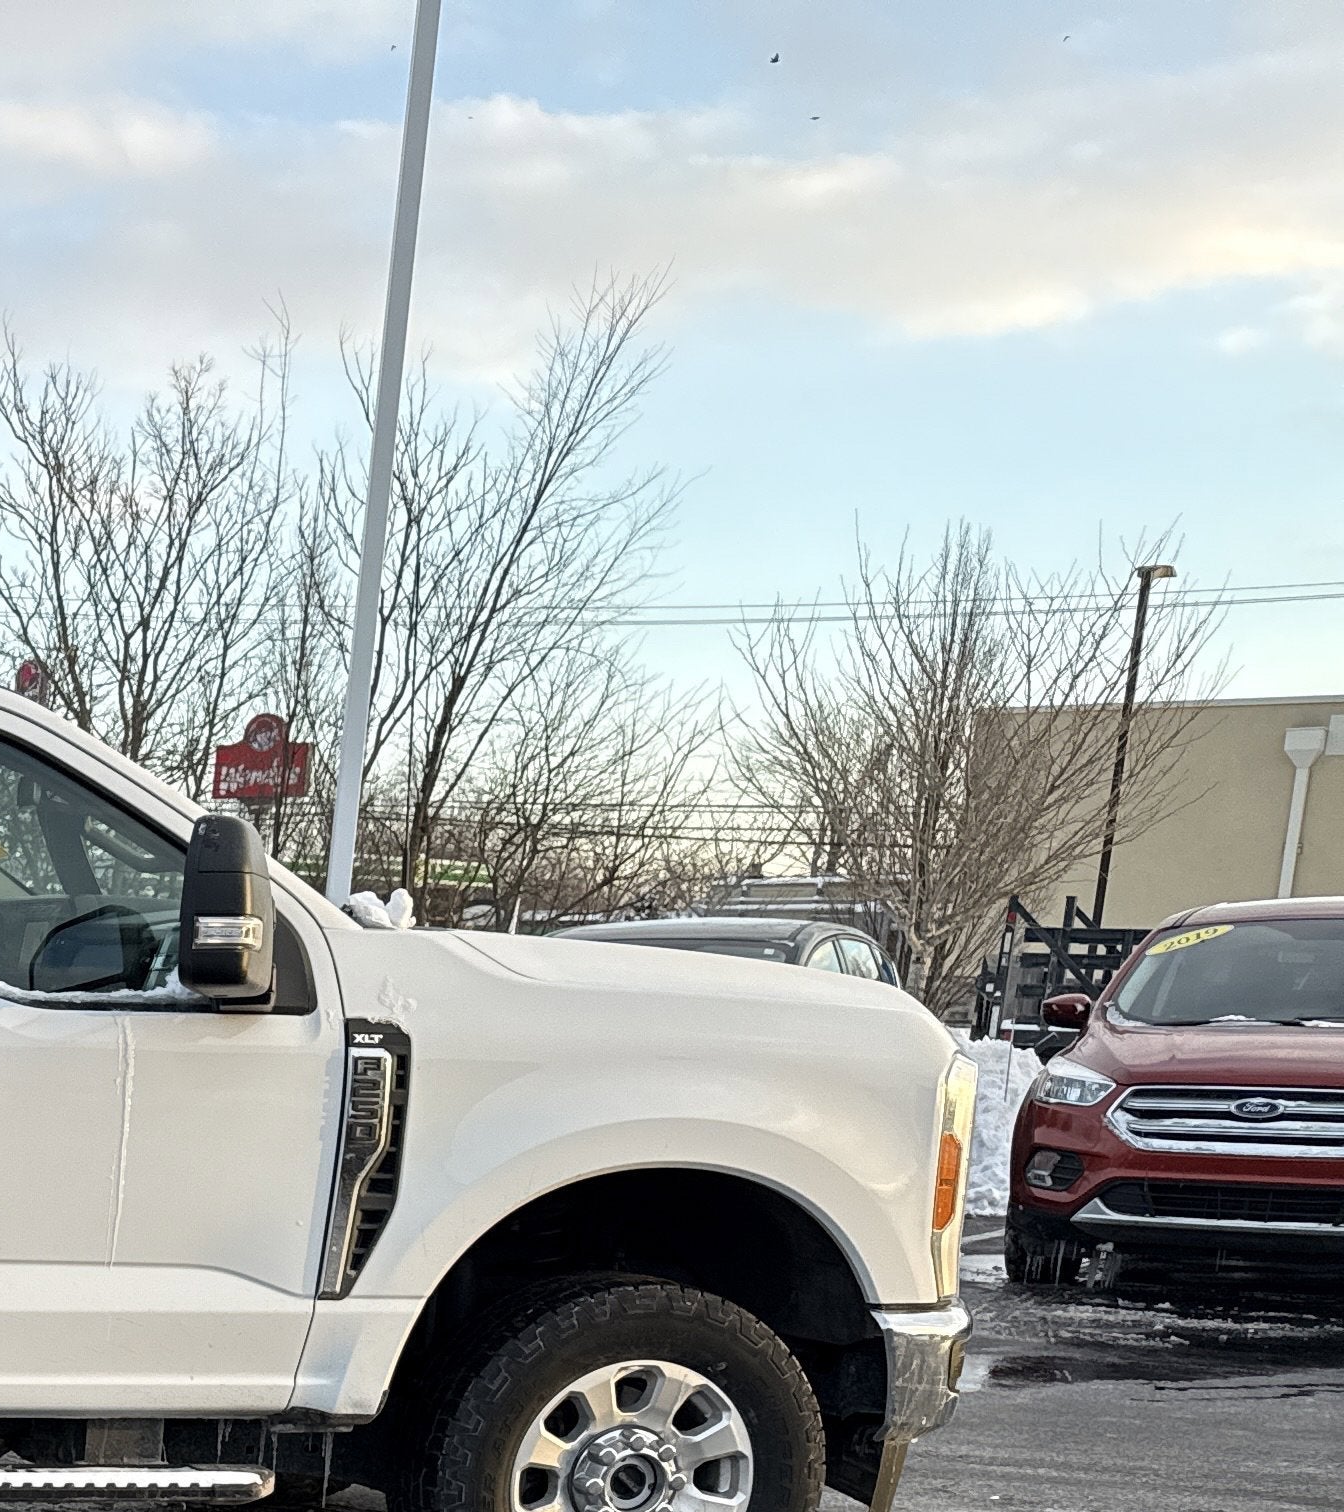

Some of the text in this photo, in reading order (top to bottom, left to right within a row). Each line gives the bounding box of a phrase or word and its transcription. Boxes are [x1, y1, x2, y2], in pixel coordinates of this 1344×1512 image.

[219, 757, 301, 795] Wends
[1163, 928, 1219, 951] 2019
[352, 1033, 383, 1044] XLT
